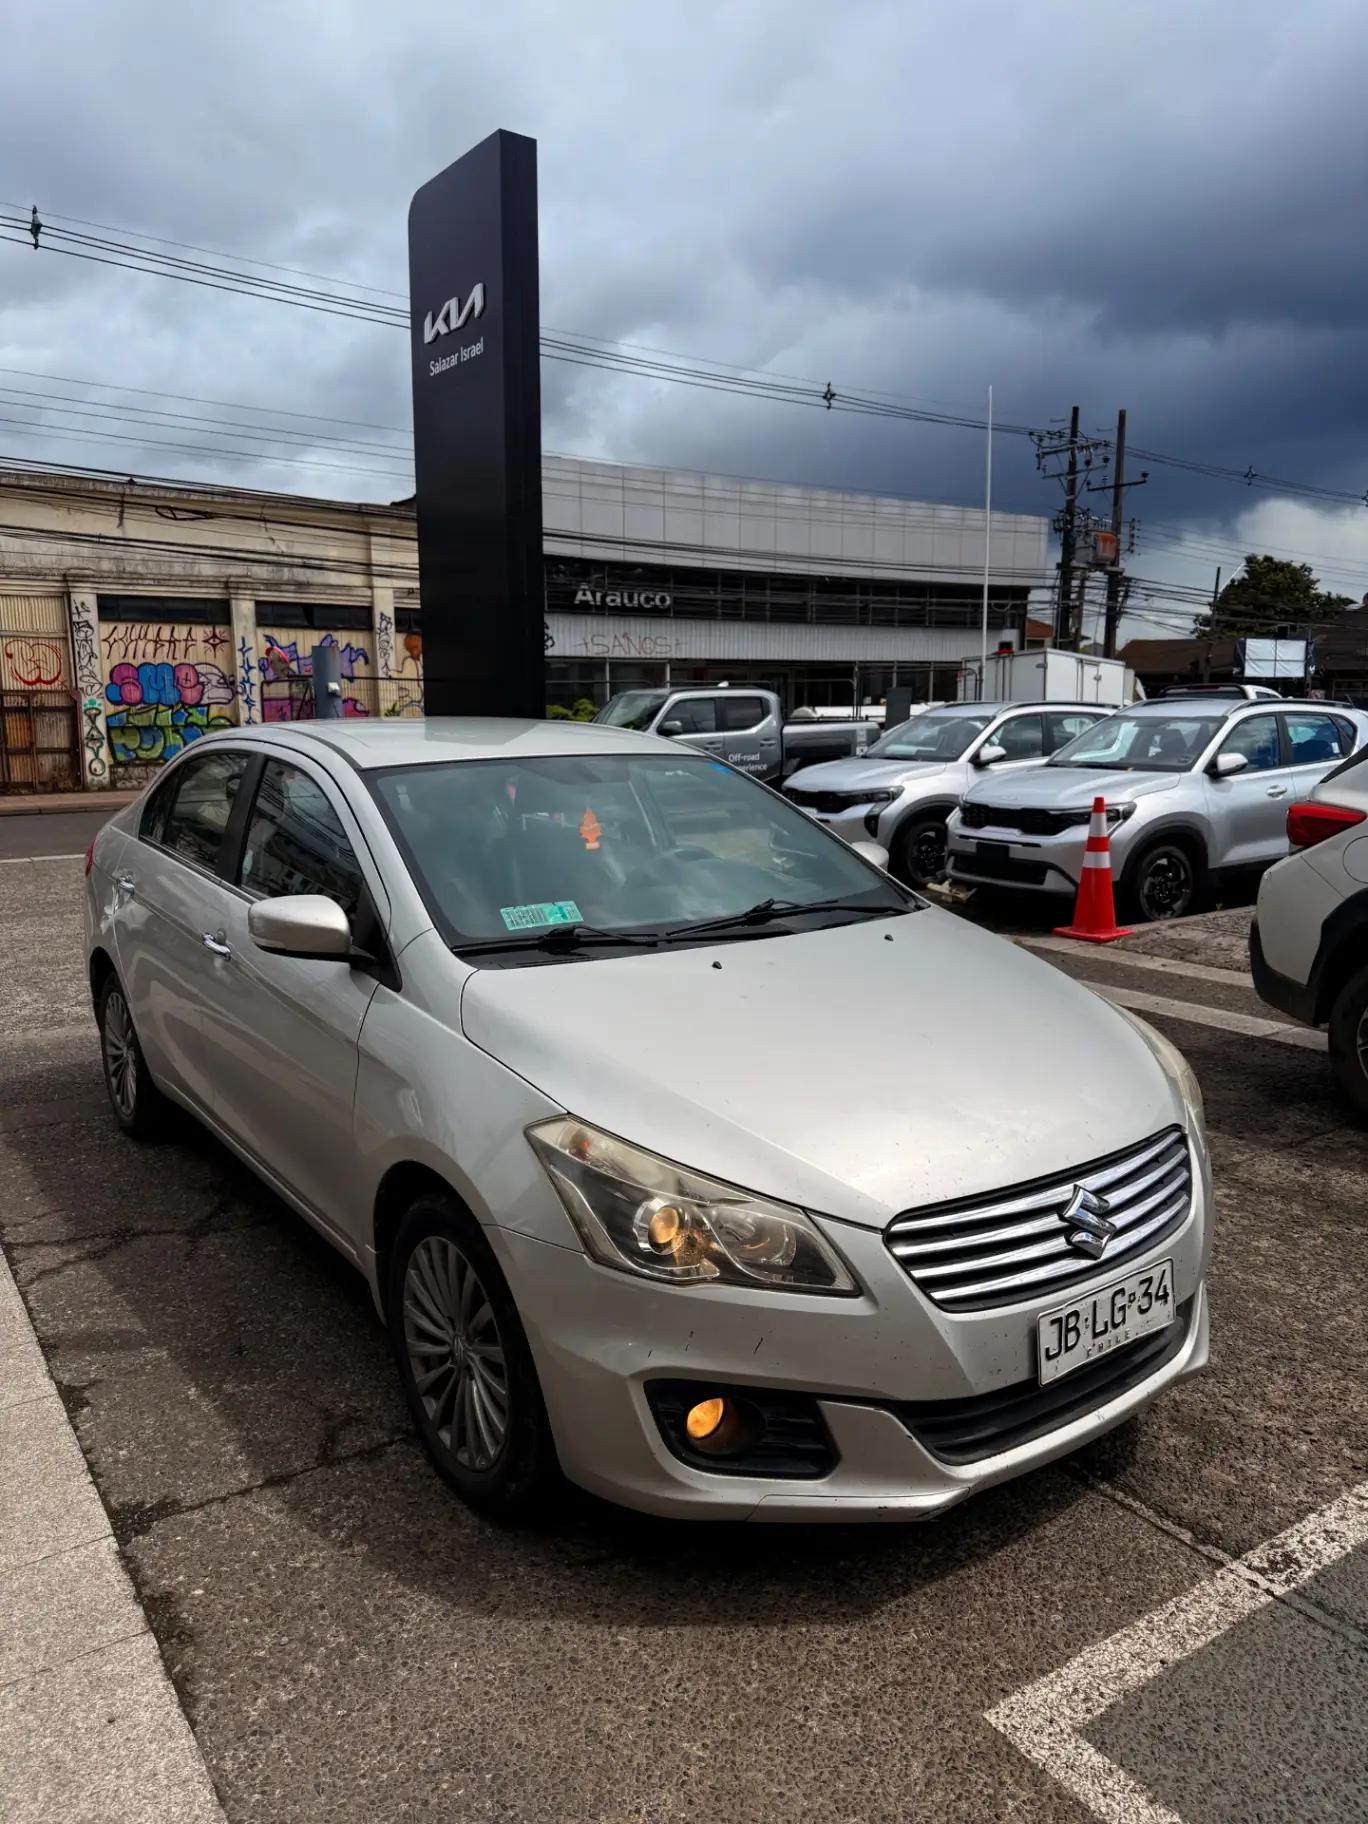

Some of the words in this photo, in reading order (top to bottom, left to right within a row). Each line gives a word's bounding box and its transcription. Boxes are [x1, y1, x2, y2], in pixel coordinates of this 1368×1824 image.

[424, 282, 484, 344] KIA
[429, 352, 459, 377] Salazar
[460, 336, 484, 362] Israel
[573, 583, 671, 609] Arauco
[728, 752, 760, 764] Off-road
